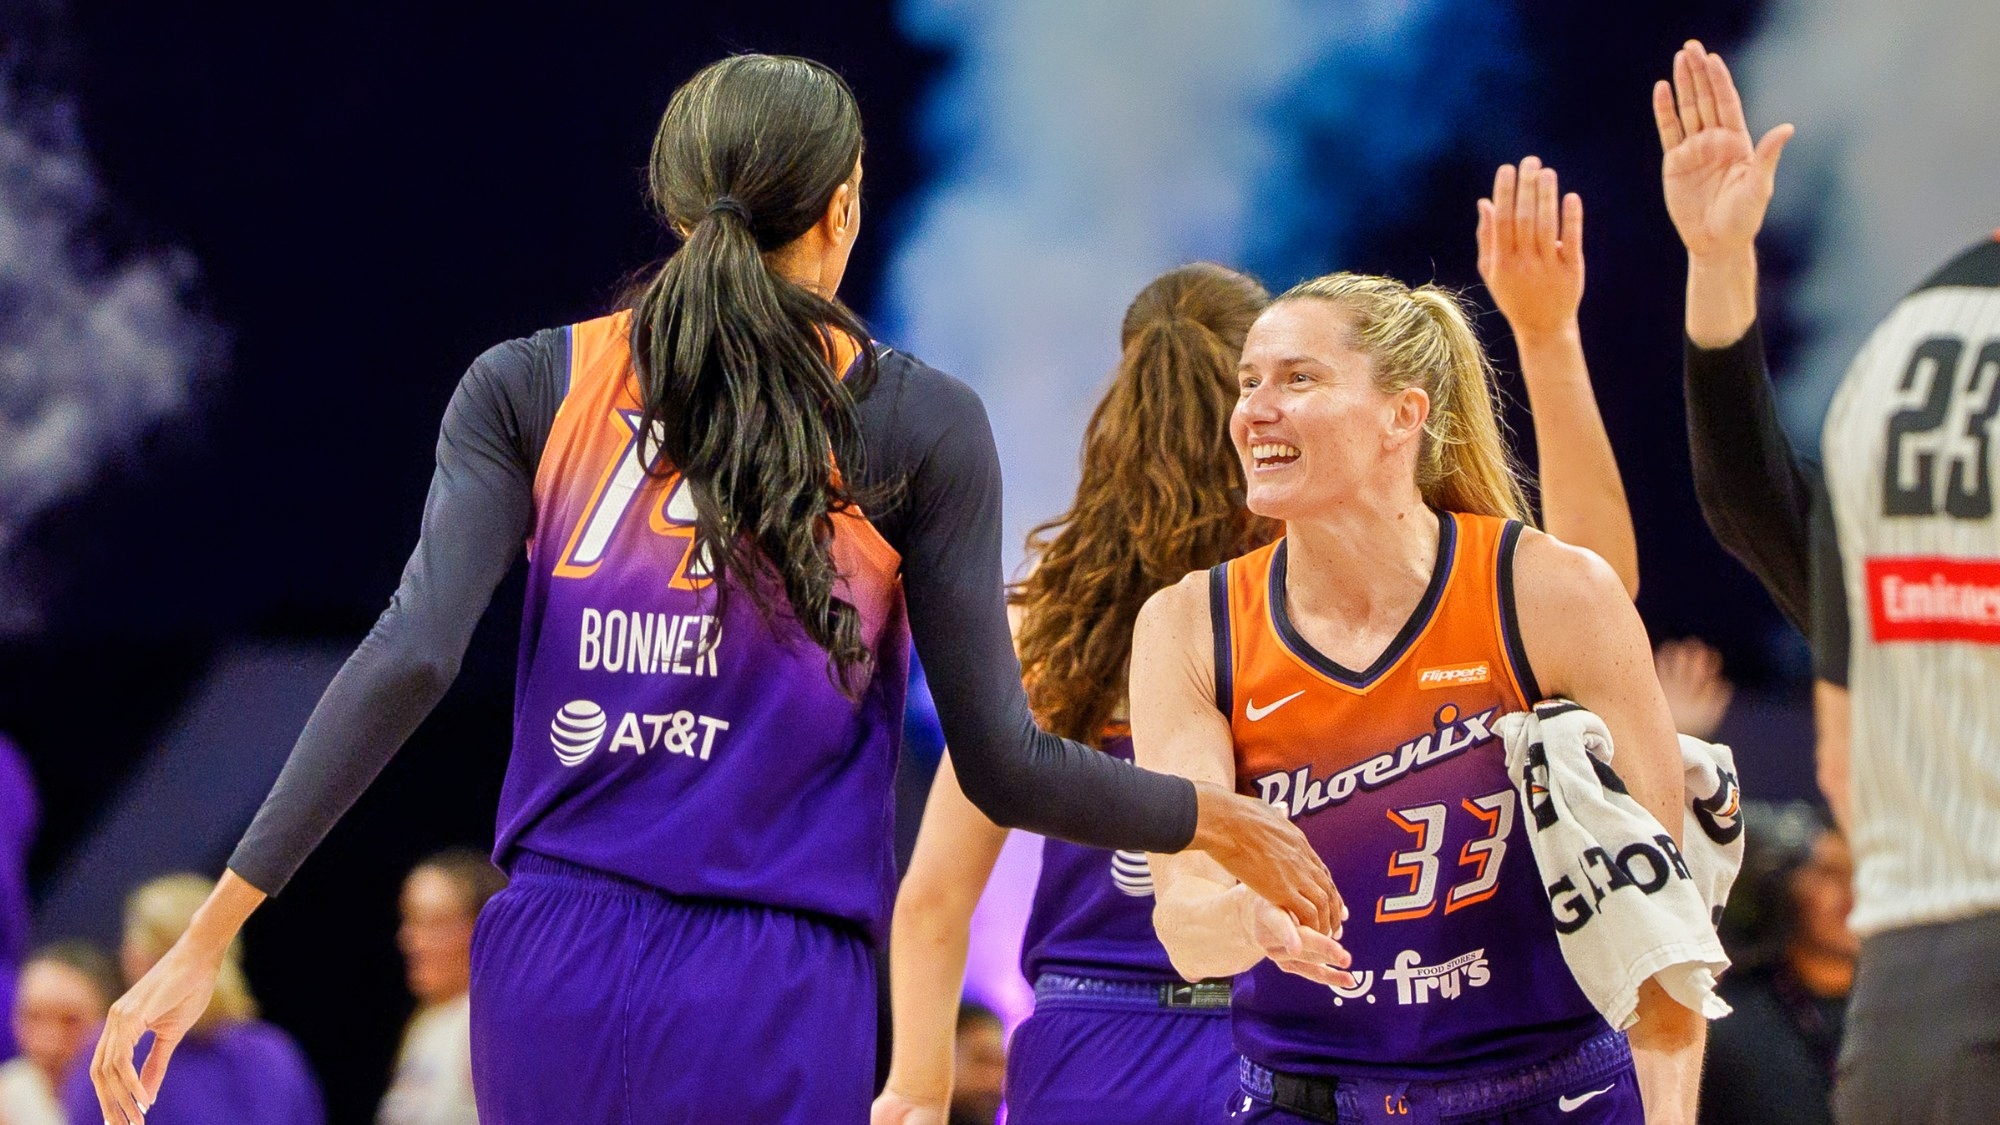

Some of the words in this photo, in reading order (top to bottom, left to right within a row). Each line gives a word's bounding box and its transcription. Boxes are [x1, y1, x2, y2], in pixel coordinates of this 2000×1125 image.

[1883, 337, 2000, 518] 23
[579, 607, 722, 677] BONNER
[609, 710, 729, 761] AT&T
[1256, 704, 1496, 818] Phoenix
[1375, 789, 1516, 923] 33
[1417, 966, 1445, 976] FOOD
[1446, 952, 1477, 971] STORES
